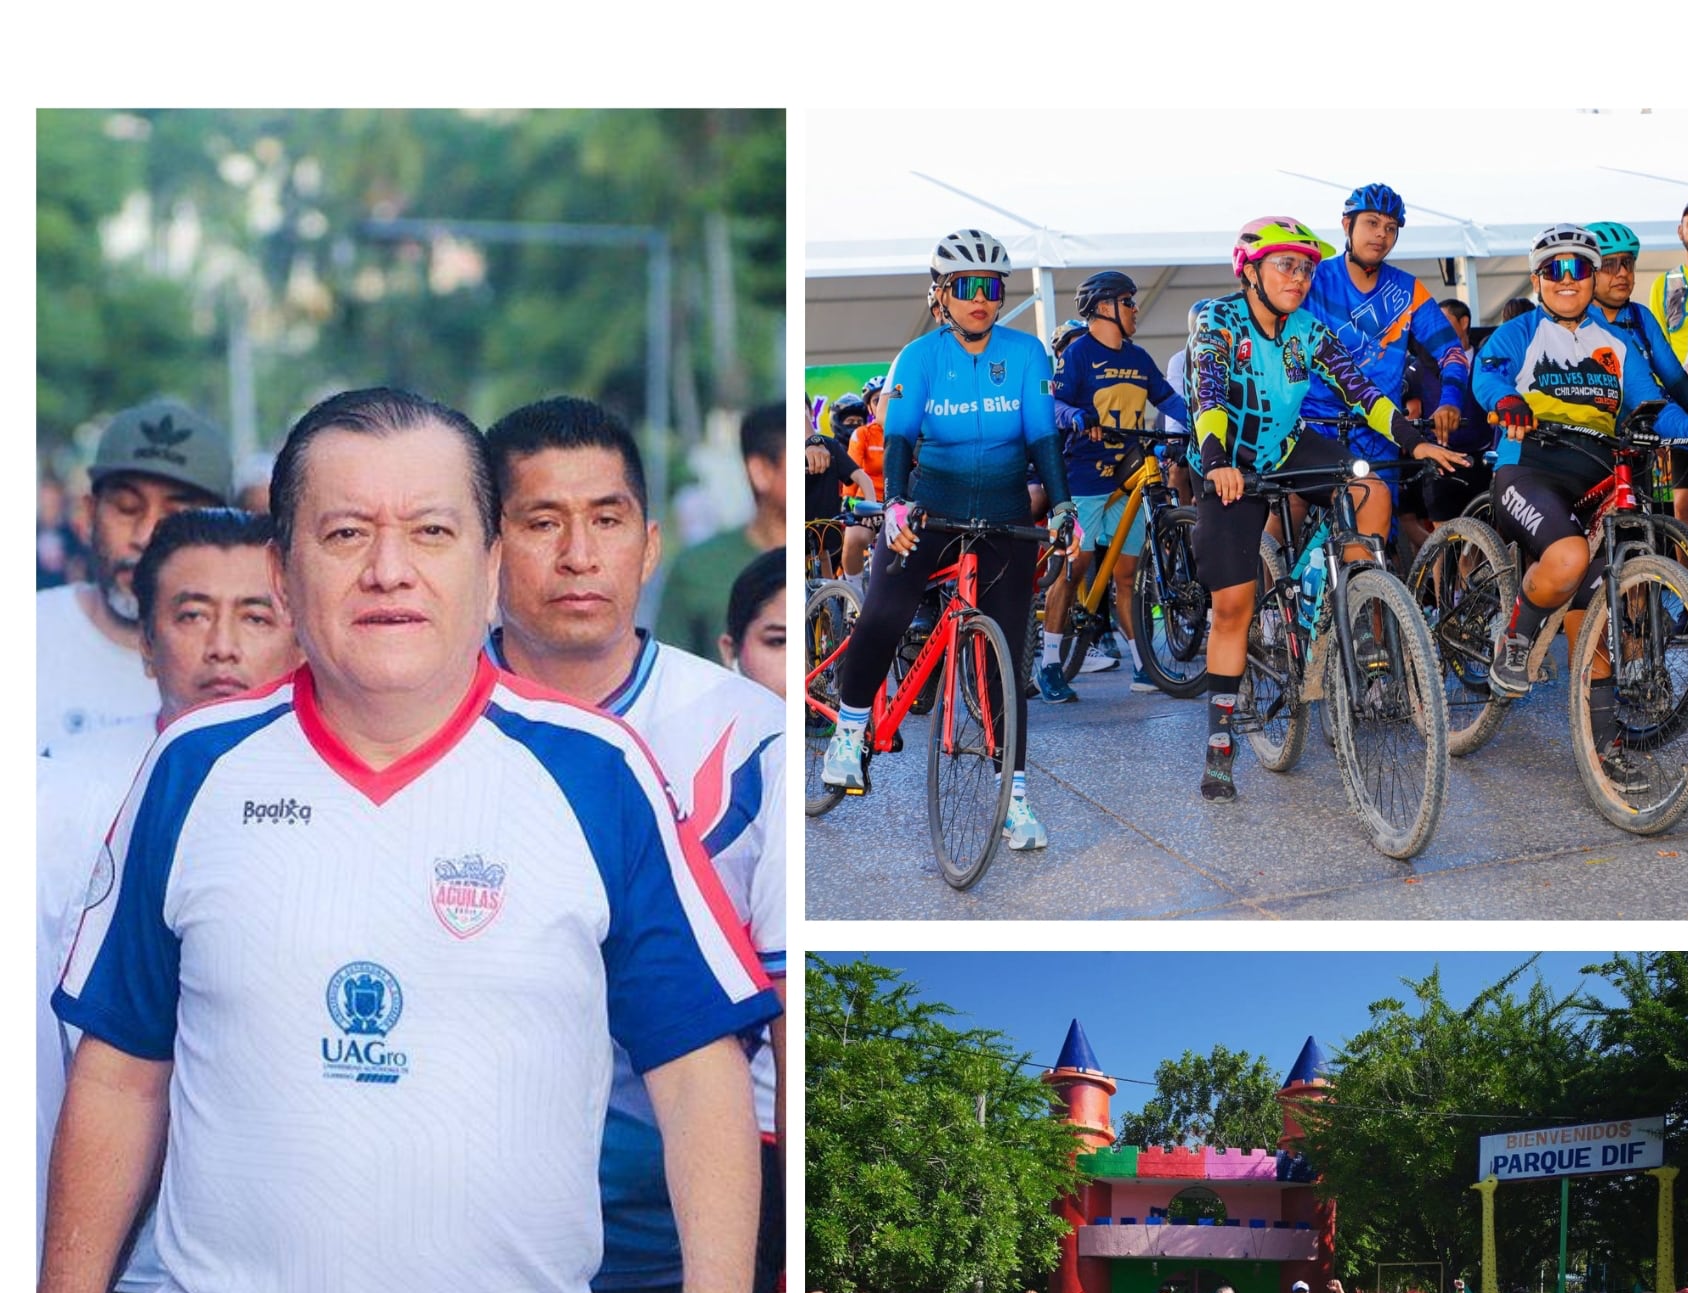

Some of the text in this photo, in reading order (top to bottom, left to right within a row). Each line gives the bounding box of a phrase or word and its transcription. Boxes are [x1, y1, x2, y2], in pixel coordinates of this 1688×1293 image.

[1104, 367, 1142, 379] DHL
[1538, 372, 1619, 388] WOLVES BIKERS
[1501, 485, 1545, 536] STRAVA
[322, 1038, 407, 1067] UAGro
[1507, 1121, 1632, 1149] BIENVENIDOS
[1493, 1141, 1646, 1175] PARQUE DIF
